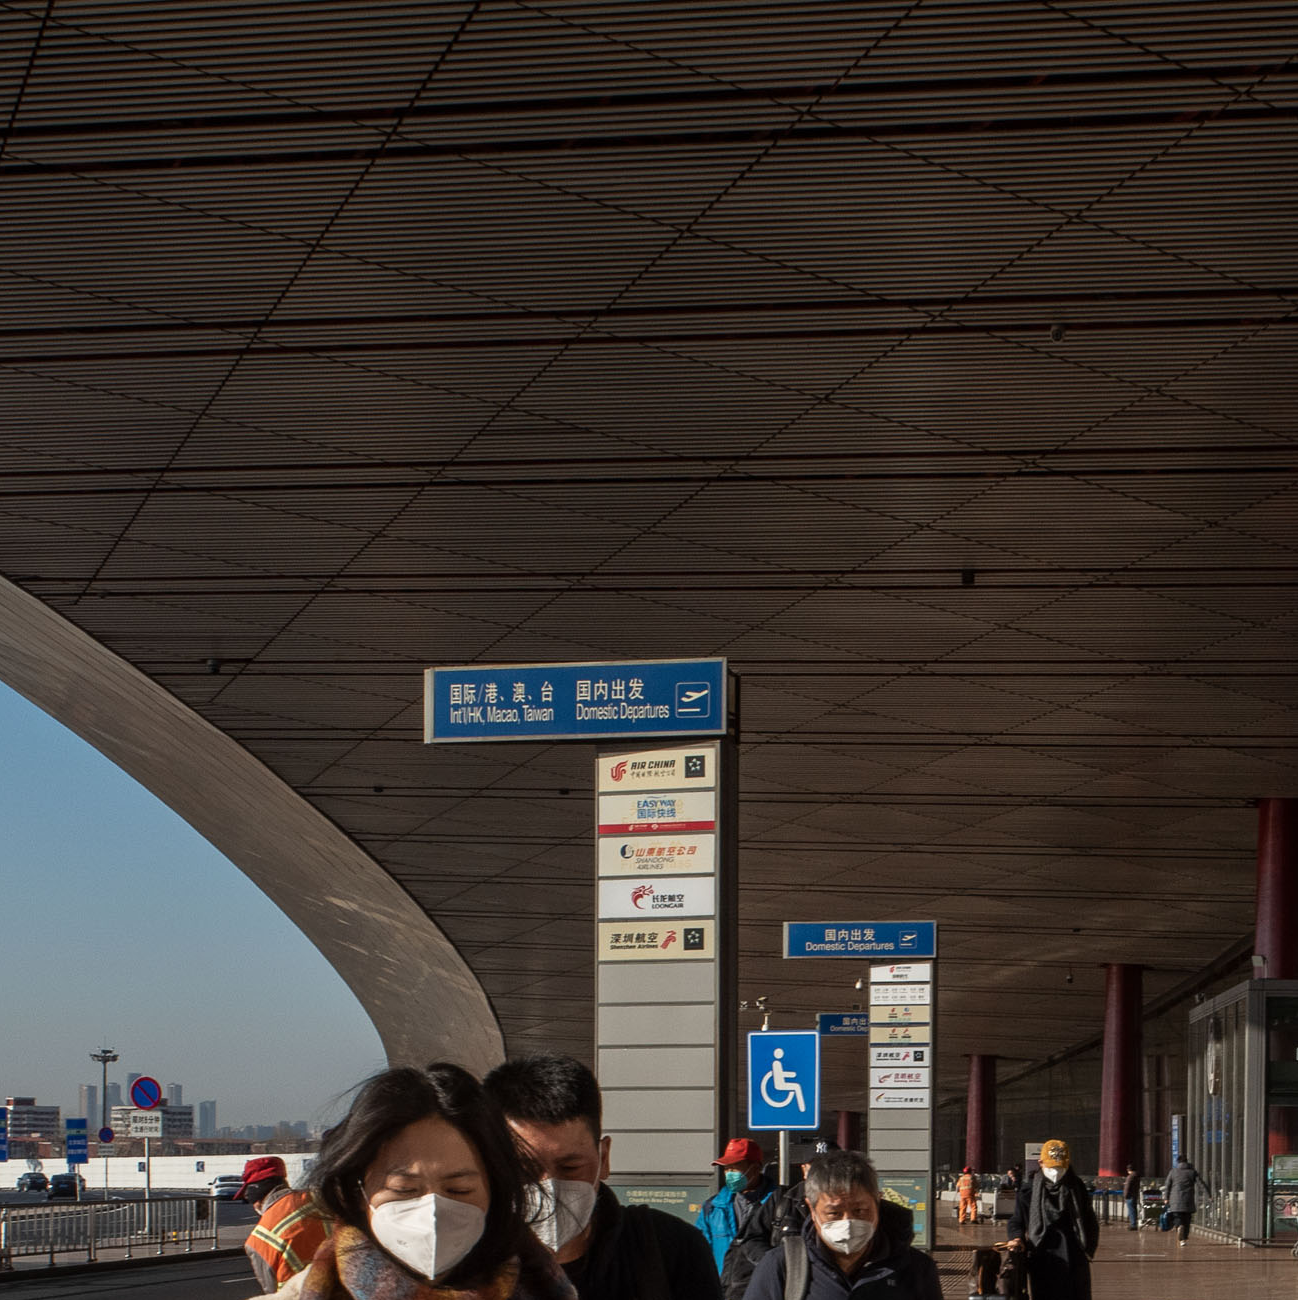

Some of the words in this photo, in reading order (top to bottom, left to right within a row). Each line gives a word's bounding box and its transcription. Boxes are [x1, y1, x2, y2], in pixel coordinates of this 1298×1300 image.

[576, 678, 644, 701] 国内出发
[487, 706, 521, 724] Macao,
[522, 704, 554, 721] Taiwan
[576, 703, 618, 720] Domestic
[620, 702, 669, 723] Departures
[631, 760, 646, 770] AIR
[648, 760, 676, 769] CHINA
[610, 932, 659, 944] 深圳航空
[825, 928, 875, 941] 国内出发
[805, 942, 845, 951] Domestic
[847, 941, 894, 952] Departures
